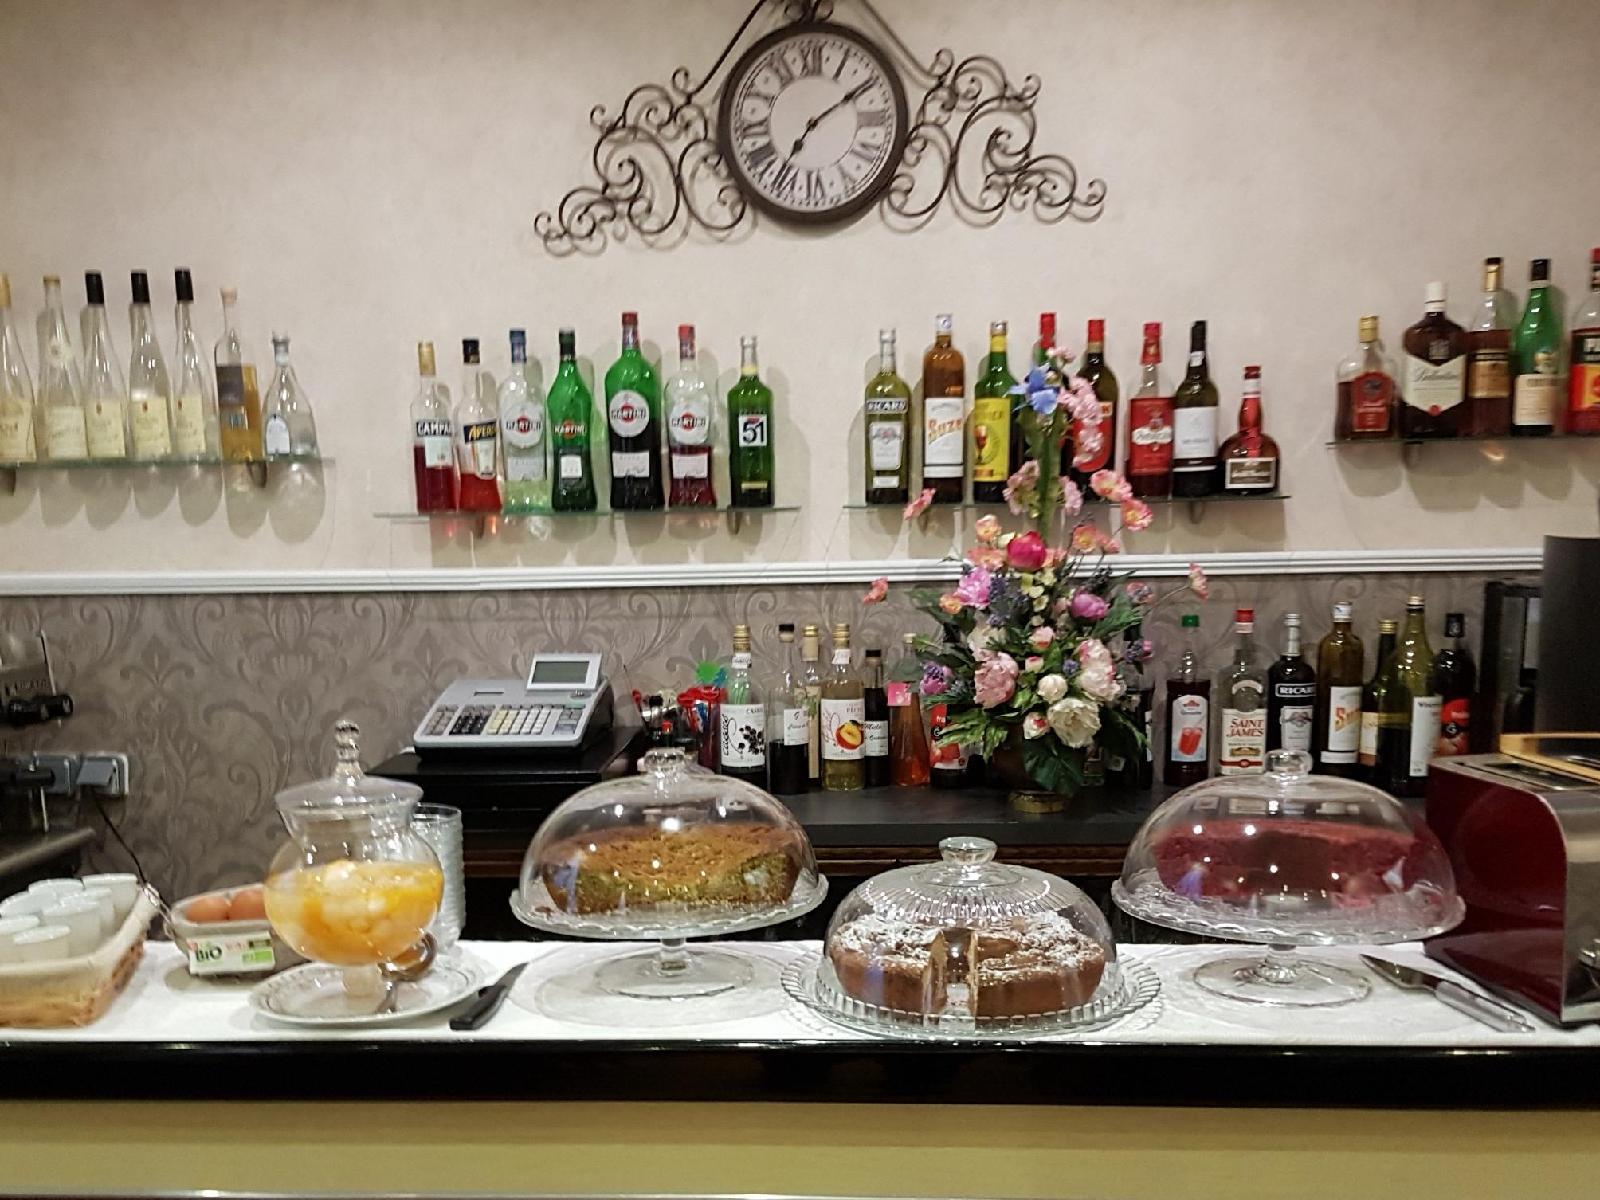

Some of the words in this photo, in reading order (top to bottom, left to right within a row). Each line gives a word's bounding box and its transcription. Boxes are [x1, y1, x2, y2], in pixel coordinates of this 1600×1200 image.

[742, 421, 764, 443] 51
[1230, 718, 1264, 728] SAINT
[1226, 728, 1265, 737] JAMES
